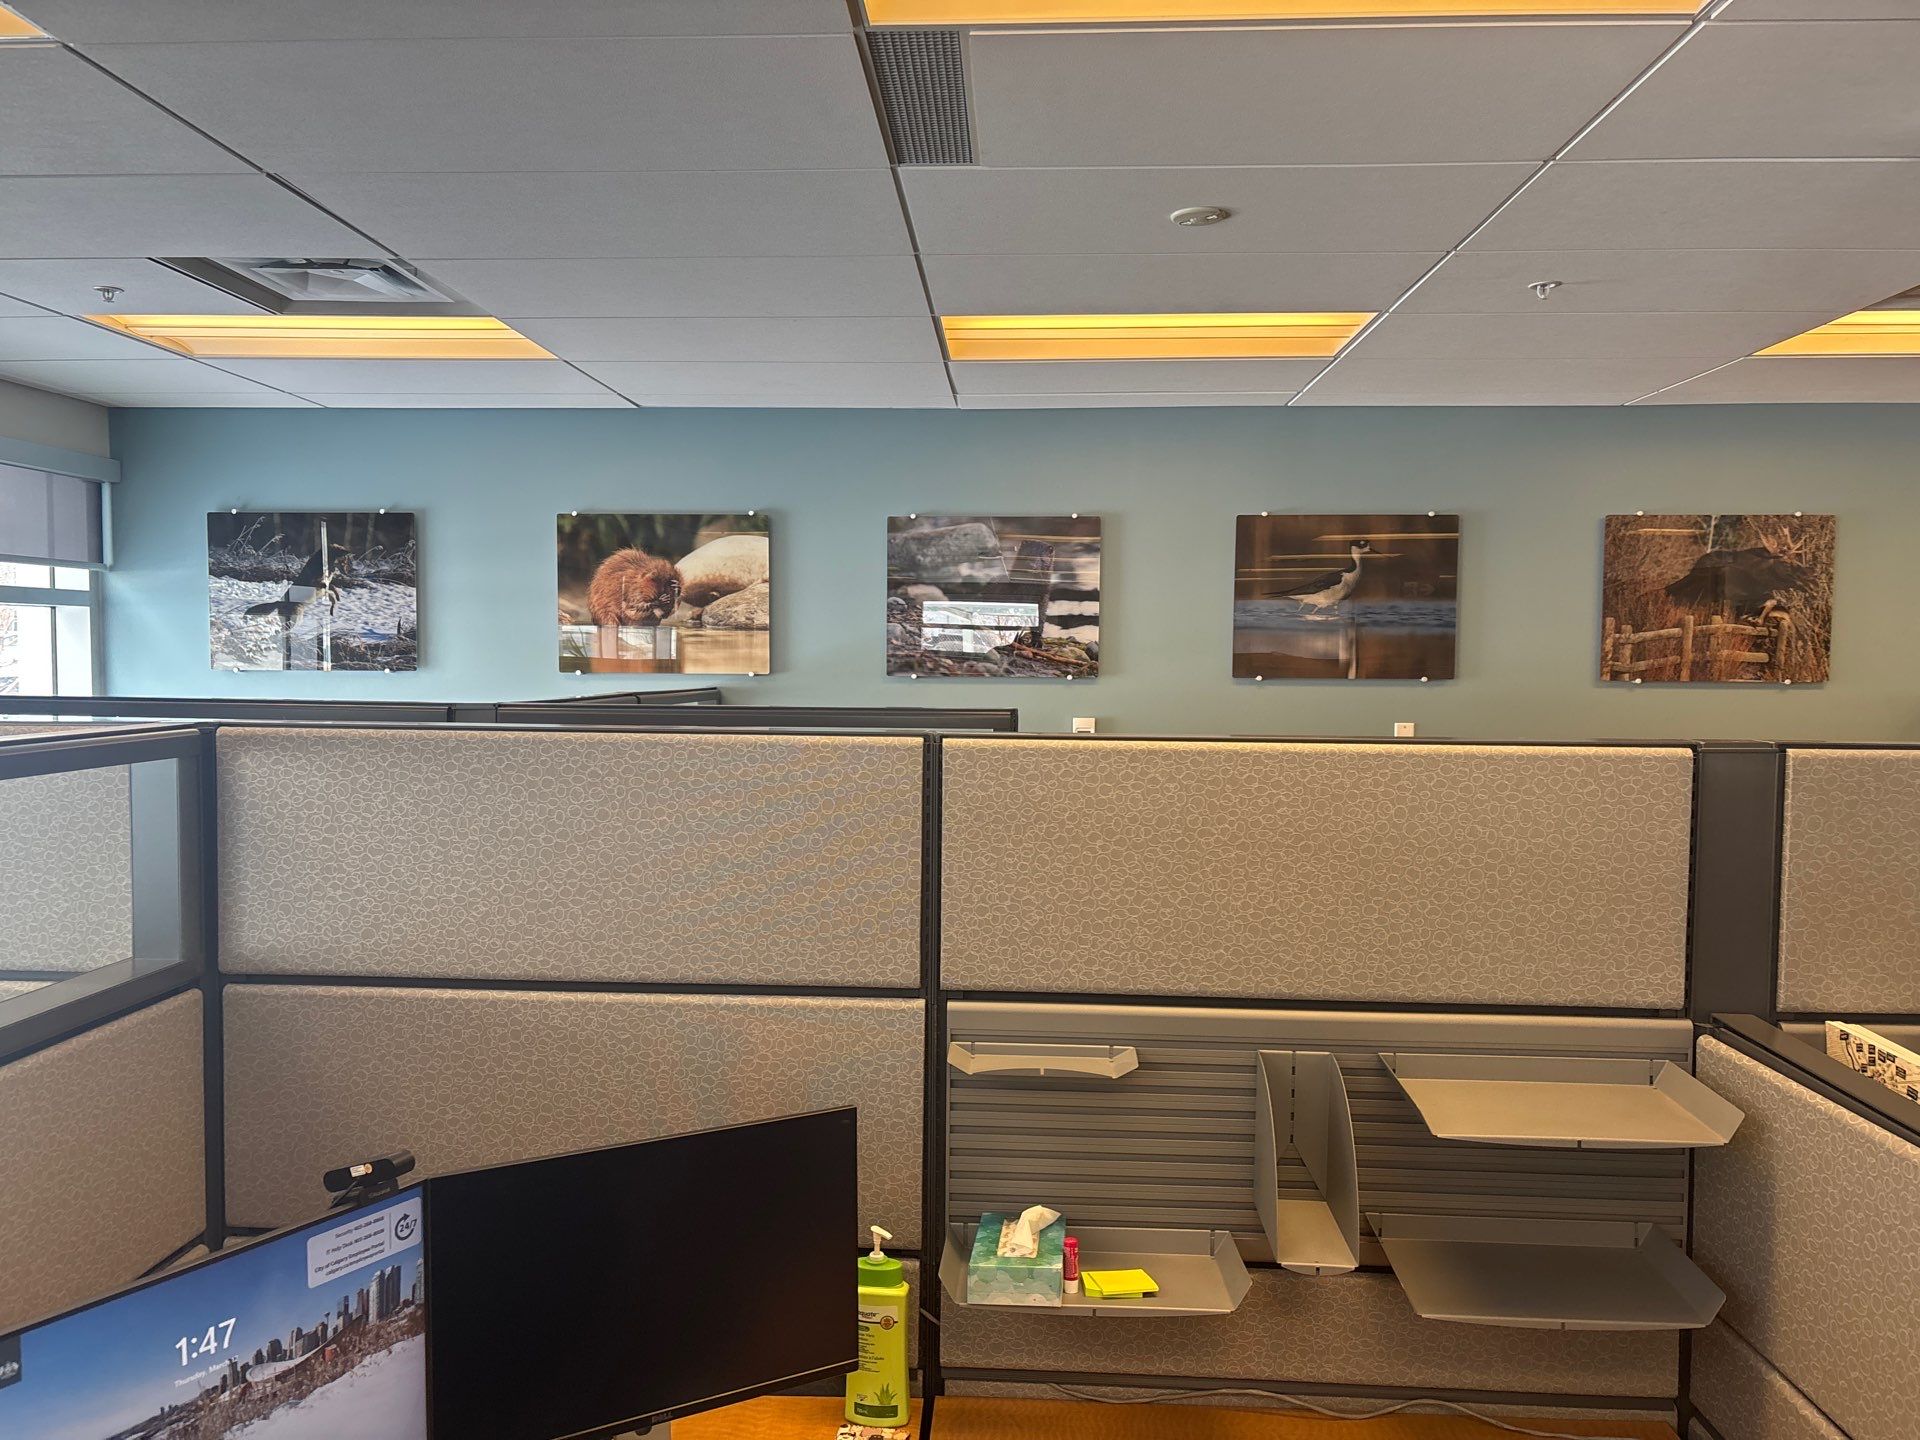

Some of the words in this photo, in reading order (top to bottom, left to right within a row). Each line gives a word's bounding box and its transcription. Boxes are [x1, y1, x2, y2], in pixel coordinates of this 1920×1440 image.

[400, 1219, 417, 1233] 24/7
[315, 1265, 324, 1273] City
[330, 1256, 348, 1267] Calgary
[175, 1317, 236, 1366] 1:47
